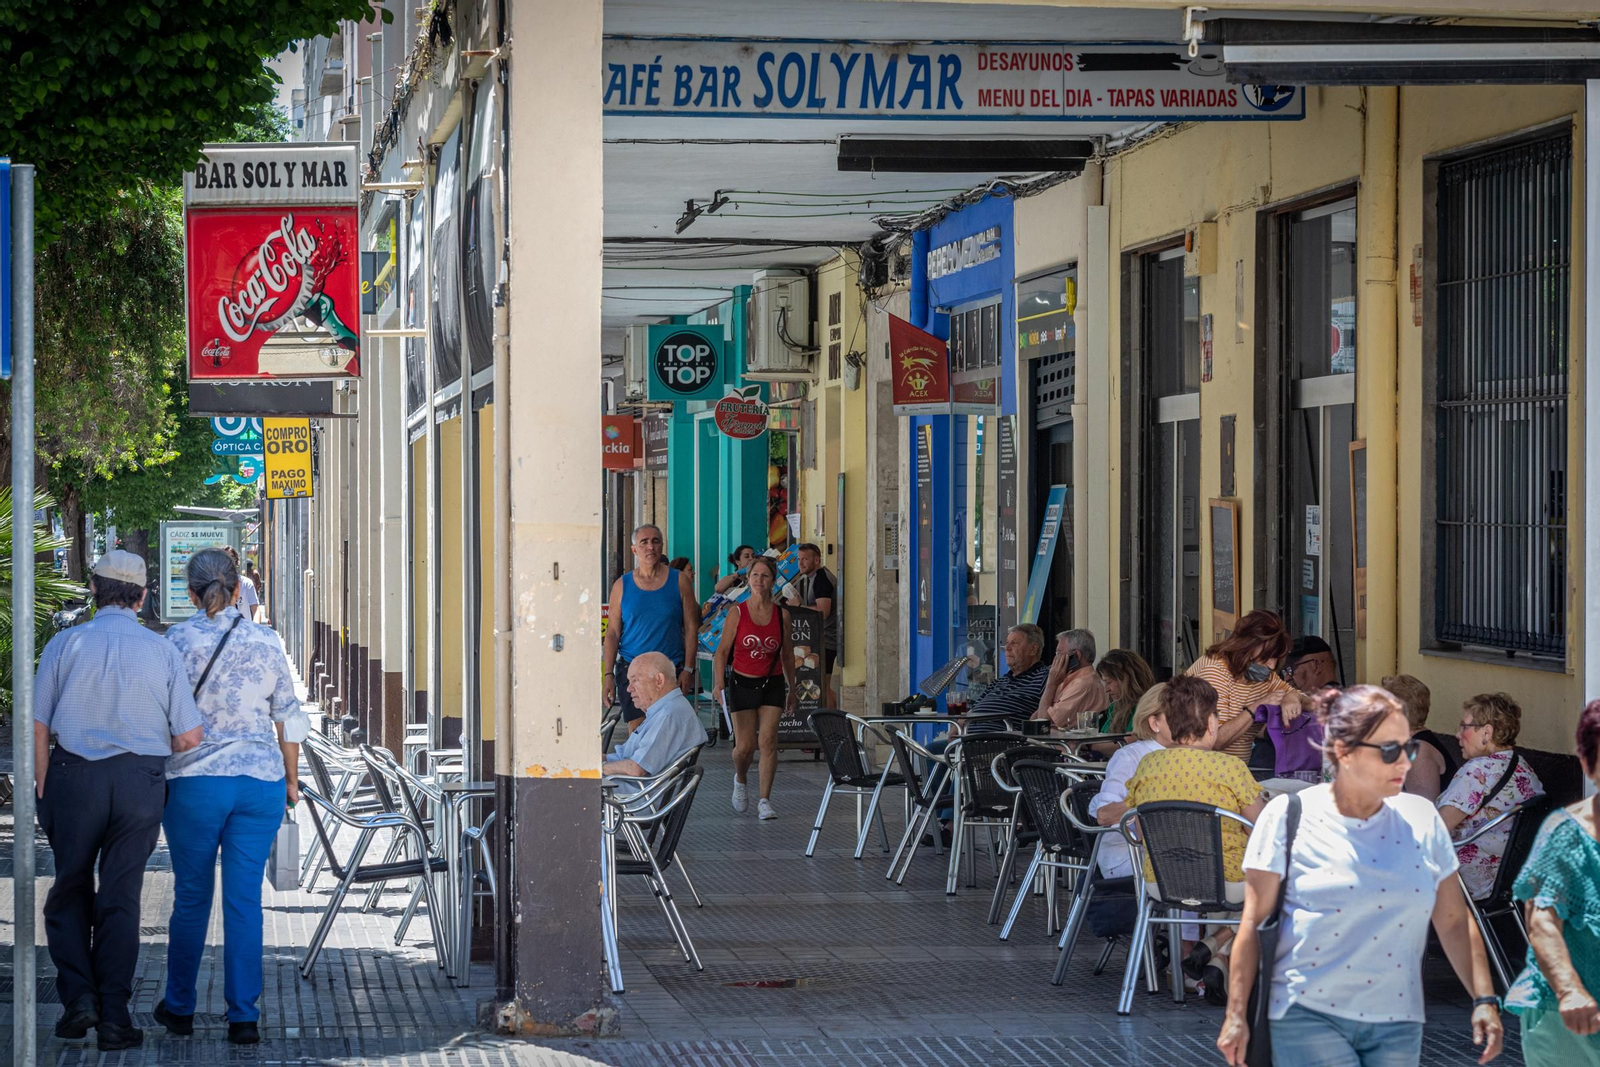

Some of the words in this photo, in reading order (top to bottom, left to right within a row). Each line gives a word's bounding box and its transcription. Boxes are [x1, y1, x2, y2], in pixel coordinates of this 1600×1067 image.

[977, 52, 1074, 71] DESAYUNOS
[673, 65, 741, 107] BAR
[754, 51, 963, 110] SOLYMAR
[978, 89, 1025, 107] MENU
[1030, 89, 1060, 107] DEL
[1066, 89, 1092, 107] DIA
[1107, 89, 1154, 107] TAPAS
[1155, 89, 1238, 107] VARIADAS
[195, 162, 237, 188] BAR
[302, 161, 348, 187] MAR
[218, 212, 318, 343] Coca-Cola
[663, 344, 710, 362] TOP
[664, 366, 710, 384] TOP
[720, 402, 771, 415] FRUTERÍA
[266, 426, 308, 440] COMPRO
[215, 441, 251, 451] ÓPTICA
[267, 440, 308, 454] ORO
[271, 469, 306, 479] PAGO
[272, 479, 307, 490] MAXIMO
